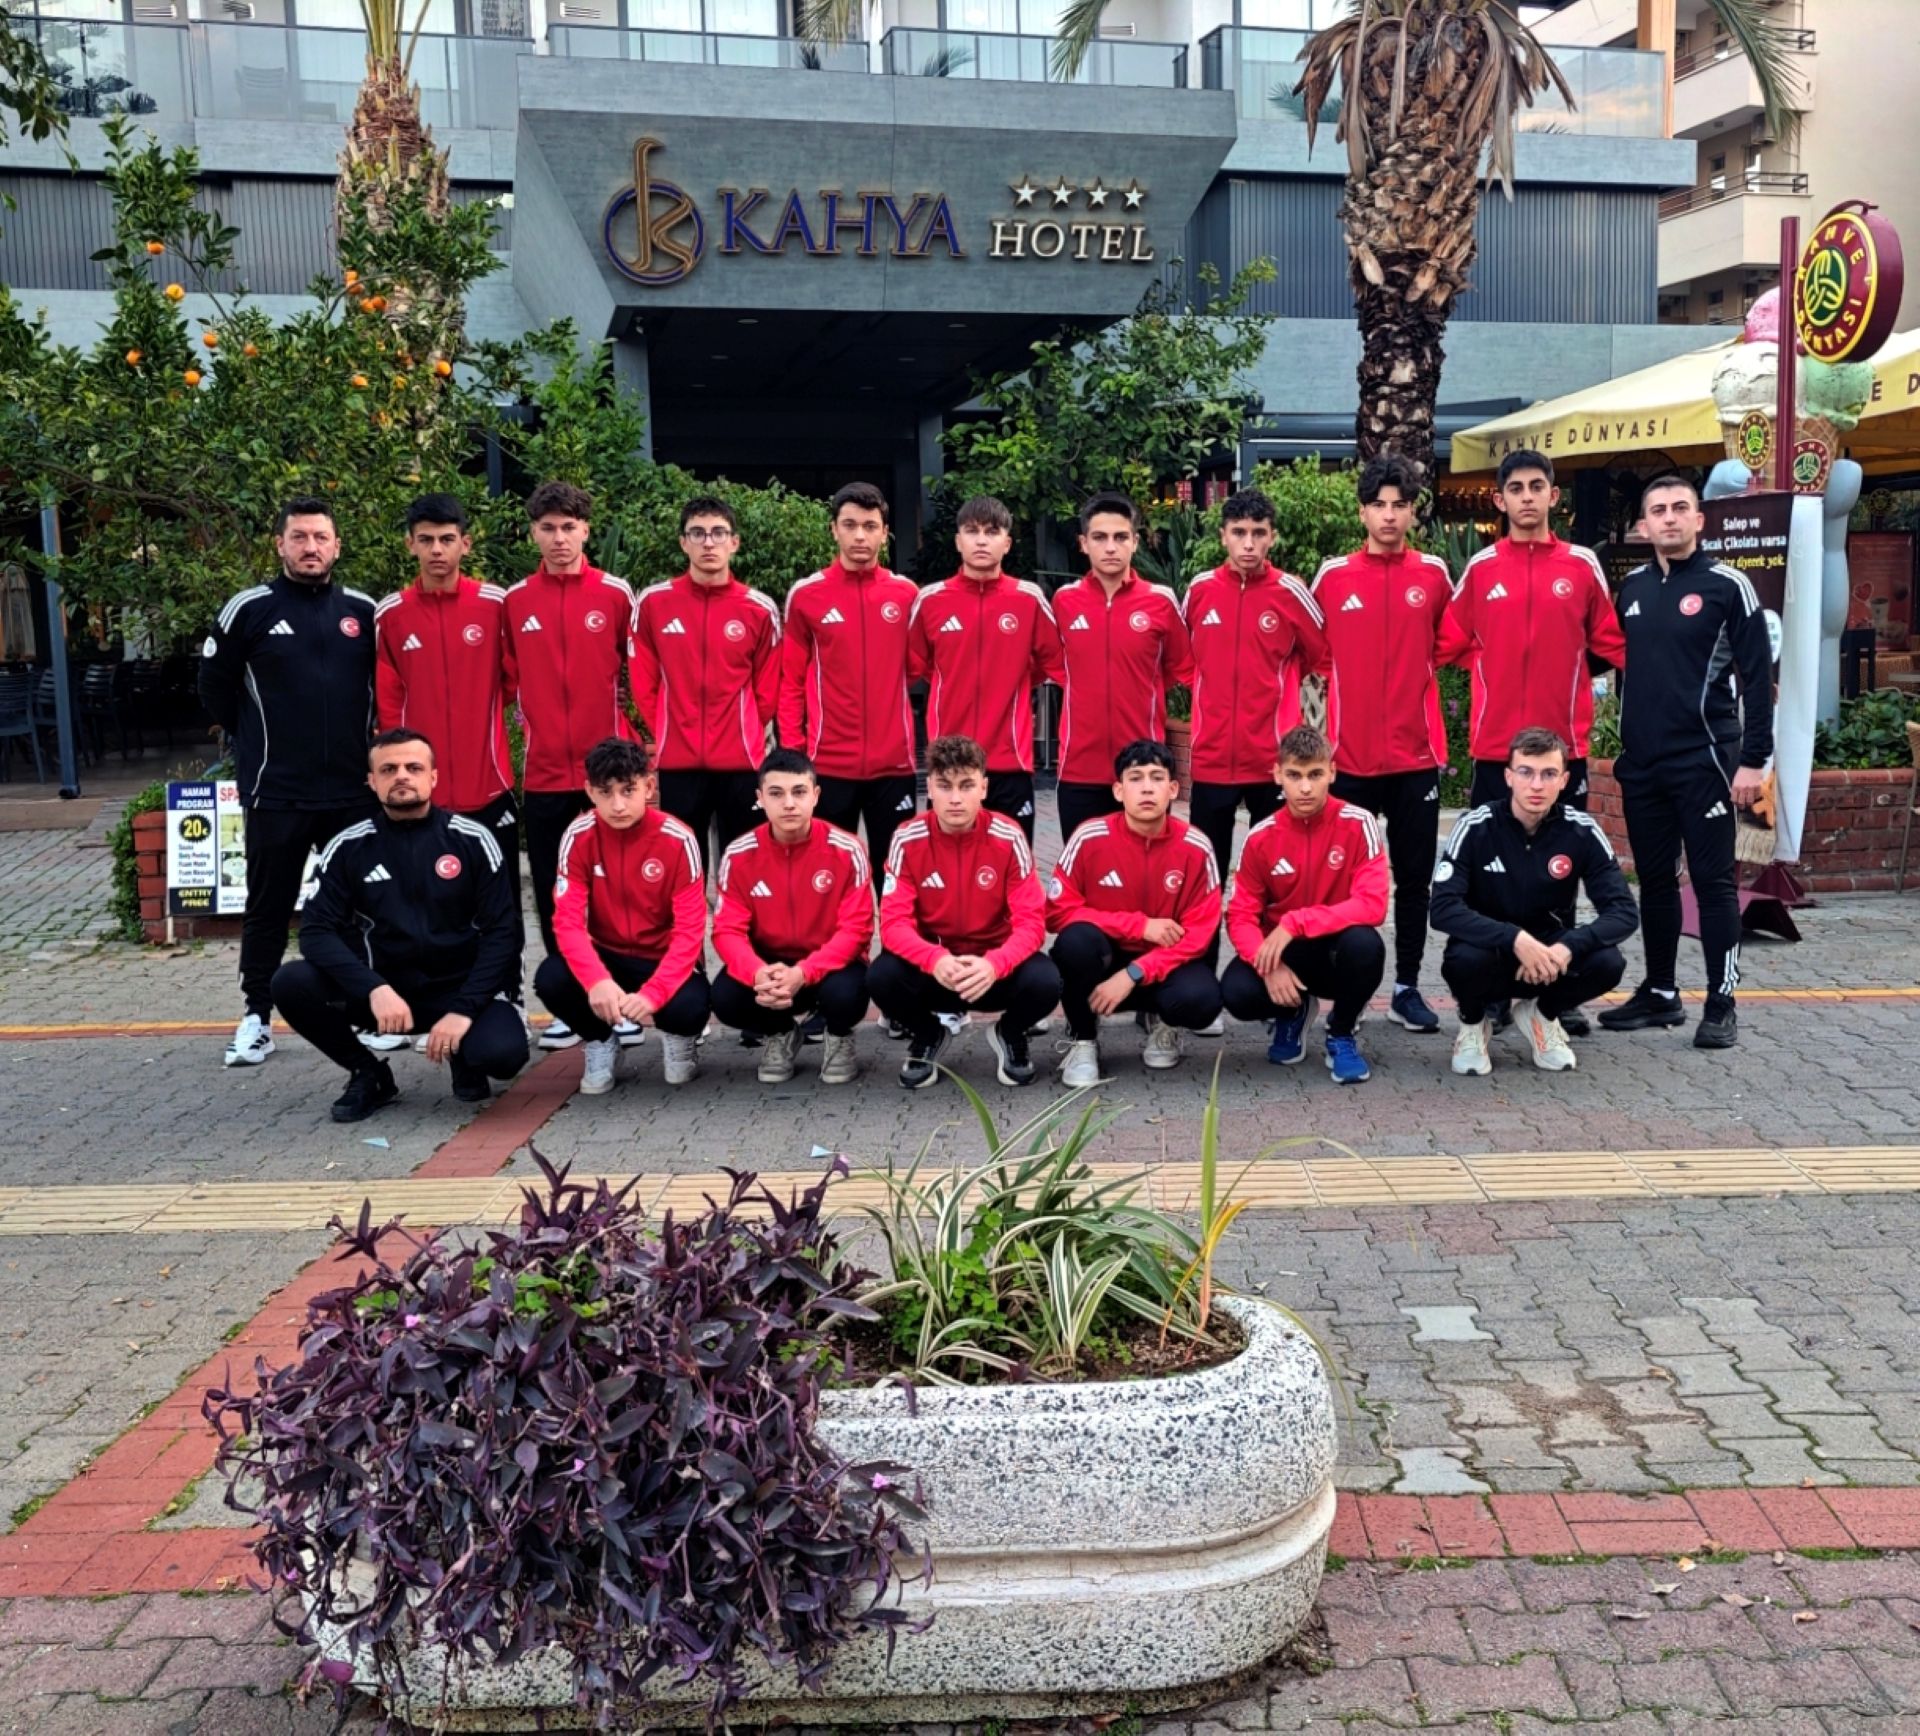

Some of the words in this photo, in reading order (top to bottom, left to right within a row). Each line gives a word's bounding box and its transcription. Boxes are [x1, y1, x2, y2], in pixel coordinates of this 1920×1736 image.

[717, 187, 968, 258] KAHYA
[990, 220, 1155, 262] HOTEL
[1489, 432, 1553, 458] KAHVE
[1568, 417, 1669, 445] DÜNYASI
[1722, 517, 1748, 532] Salep
[1749, 518, 1761, 528] ve
[1724, 535, 1760, 552] Çikolata
[1761, 536, 1787, 547] varsa
[181, 786, 211, 797] HAMAM
[176, 799, 215, 809] PROGRAM
[178, 888, 213, 898] ENTRY
[181, 898, 210, 908] FREE
